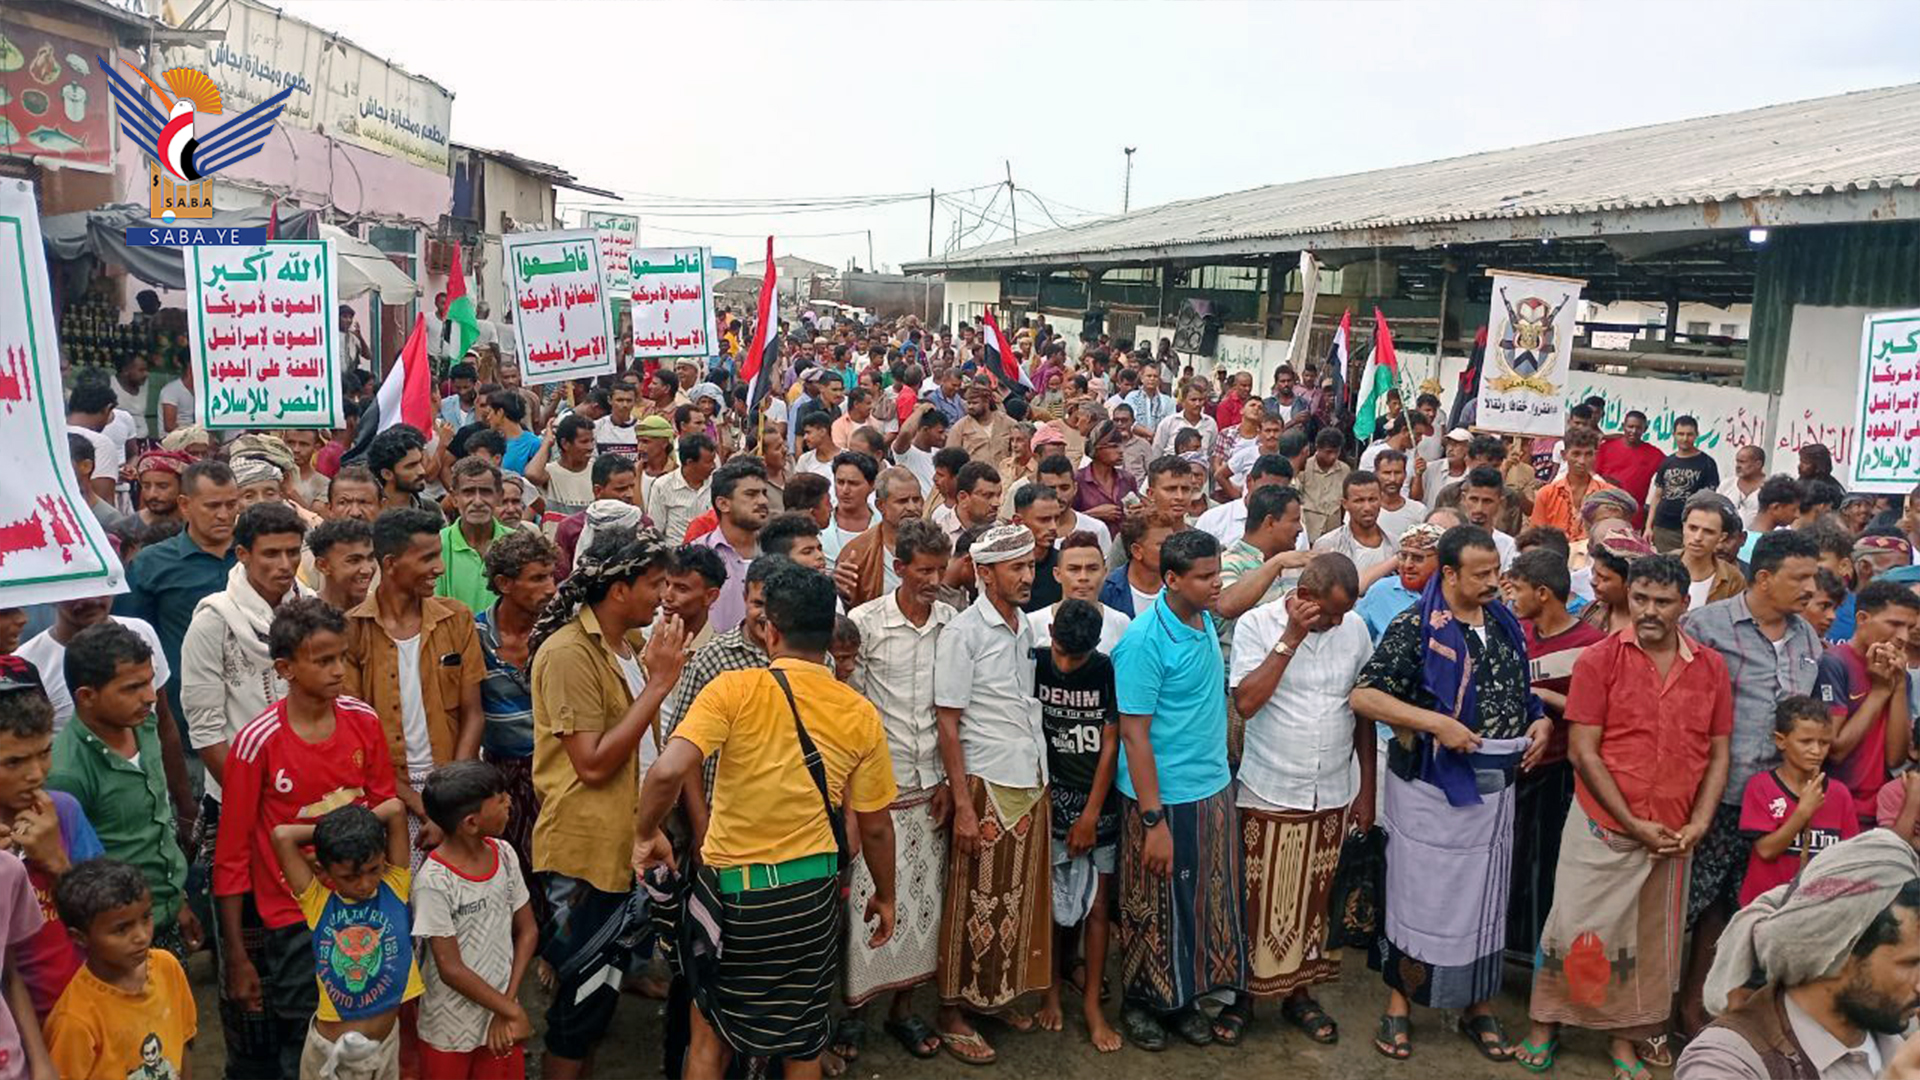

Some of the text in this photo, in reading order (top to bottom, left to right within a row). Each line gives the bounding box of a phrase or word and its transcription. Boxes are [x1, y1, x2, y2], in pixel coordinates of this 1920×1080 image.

[421, 124, 446, 146] مطعم
[203, 247, 322, 292] الله أكبر
[517, 245, 589, 283] قاطعوا
[628, 253, 700, 280] قاطعوا
[205, 290, 322, 318] الموت لأمريكا
[519, 283, 600, 315] البضائع الأمريكية
[669, 284, 701, 304] البضائع
[559, 312, 566, 333] و
[664, 308, 670, 324] و
[208, 325, 323, 351] الموت لإسرائيل
[634, 329, 704, 351] الإسرائيلية
[1874, 329, 1920, 363] كبر
[528, 336, 606, 367] الإسرائيلية
[210, 357, 324, 383] اللعنة على اليهود
[211, 384, 325, 421] النصر للإسلام
[1866, 420, 1901, 442] اليهود
[1039, 683, 1100, 708] DENIM
[1068, 723, 1101, 754] 19
[275, 768, 294, 793] 6
[357, 974, 393, 1008] JAPAN
